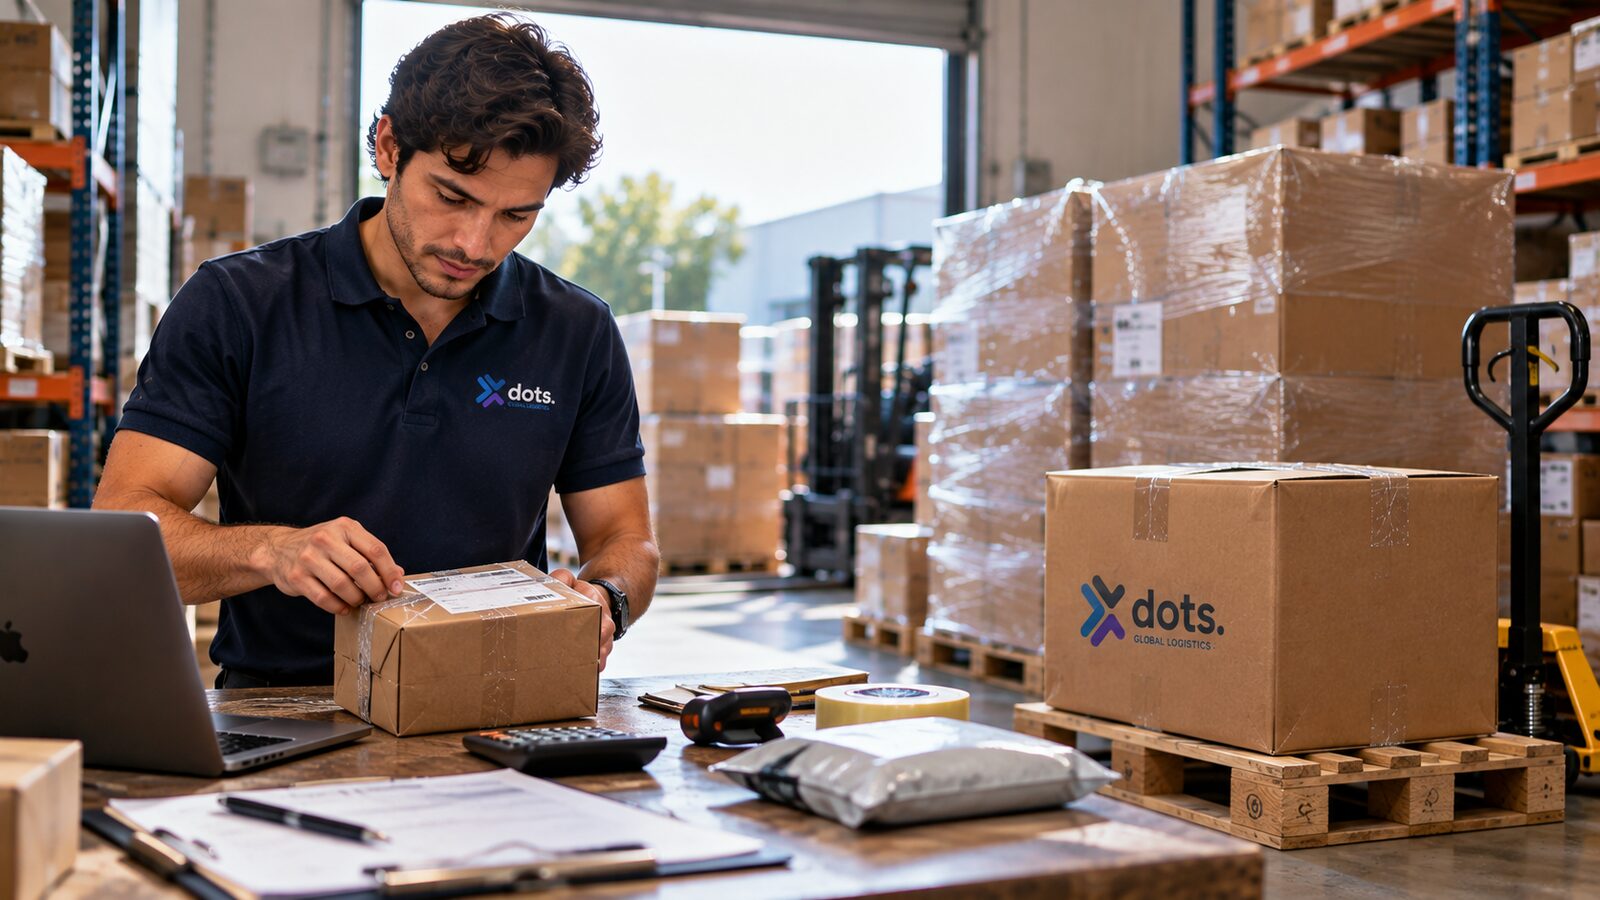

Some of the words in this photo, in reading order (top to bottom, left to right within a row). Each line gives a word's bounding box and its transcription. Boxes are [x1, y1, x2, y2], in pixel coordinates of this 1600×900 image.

[507, 383, 556, 404] dots.
[1132, 589, 1225, 636] dots.
[1133, 634, 1165, 646] GLOBAL
[1167, 638, 1212, 650] LOGISTICS
